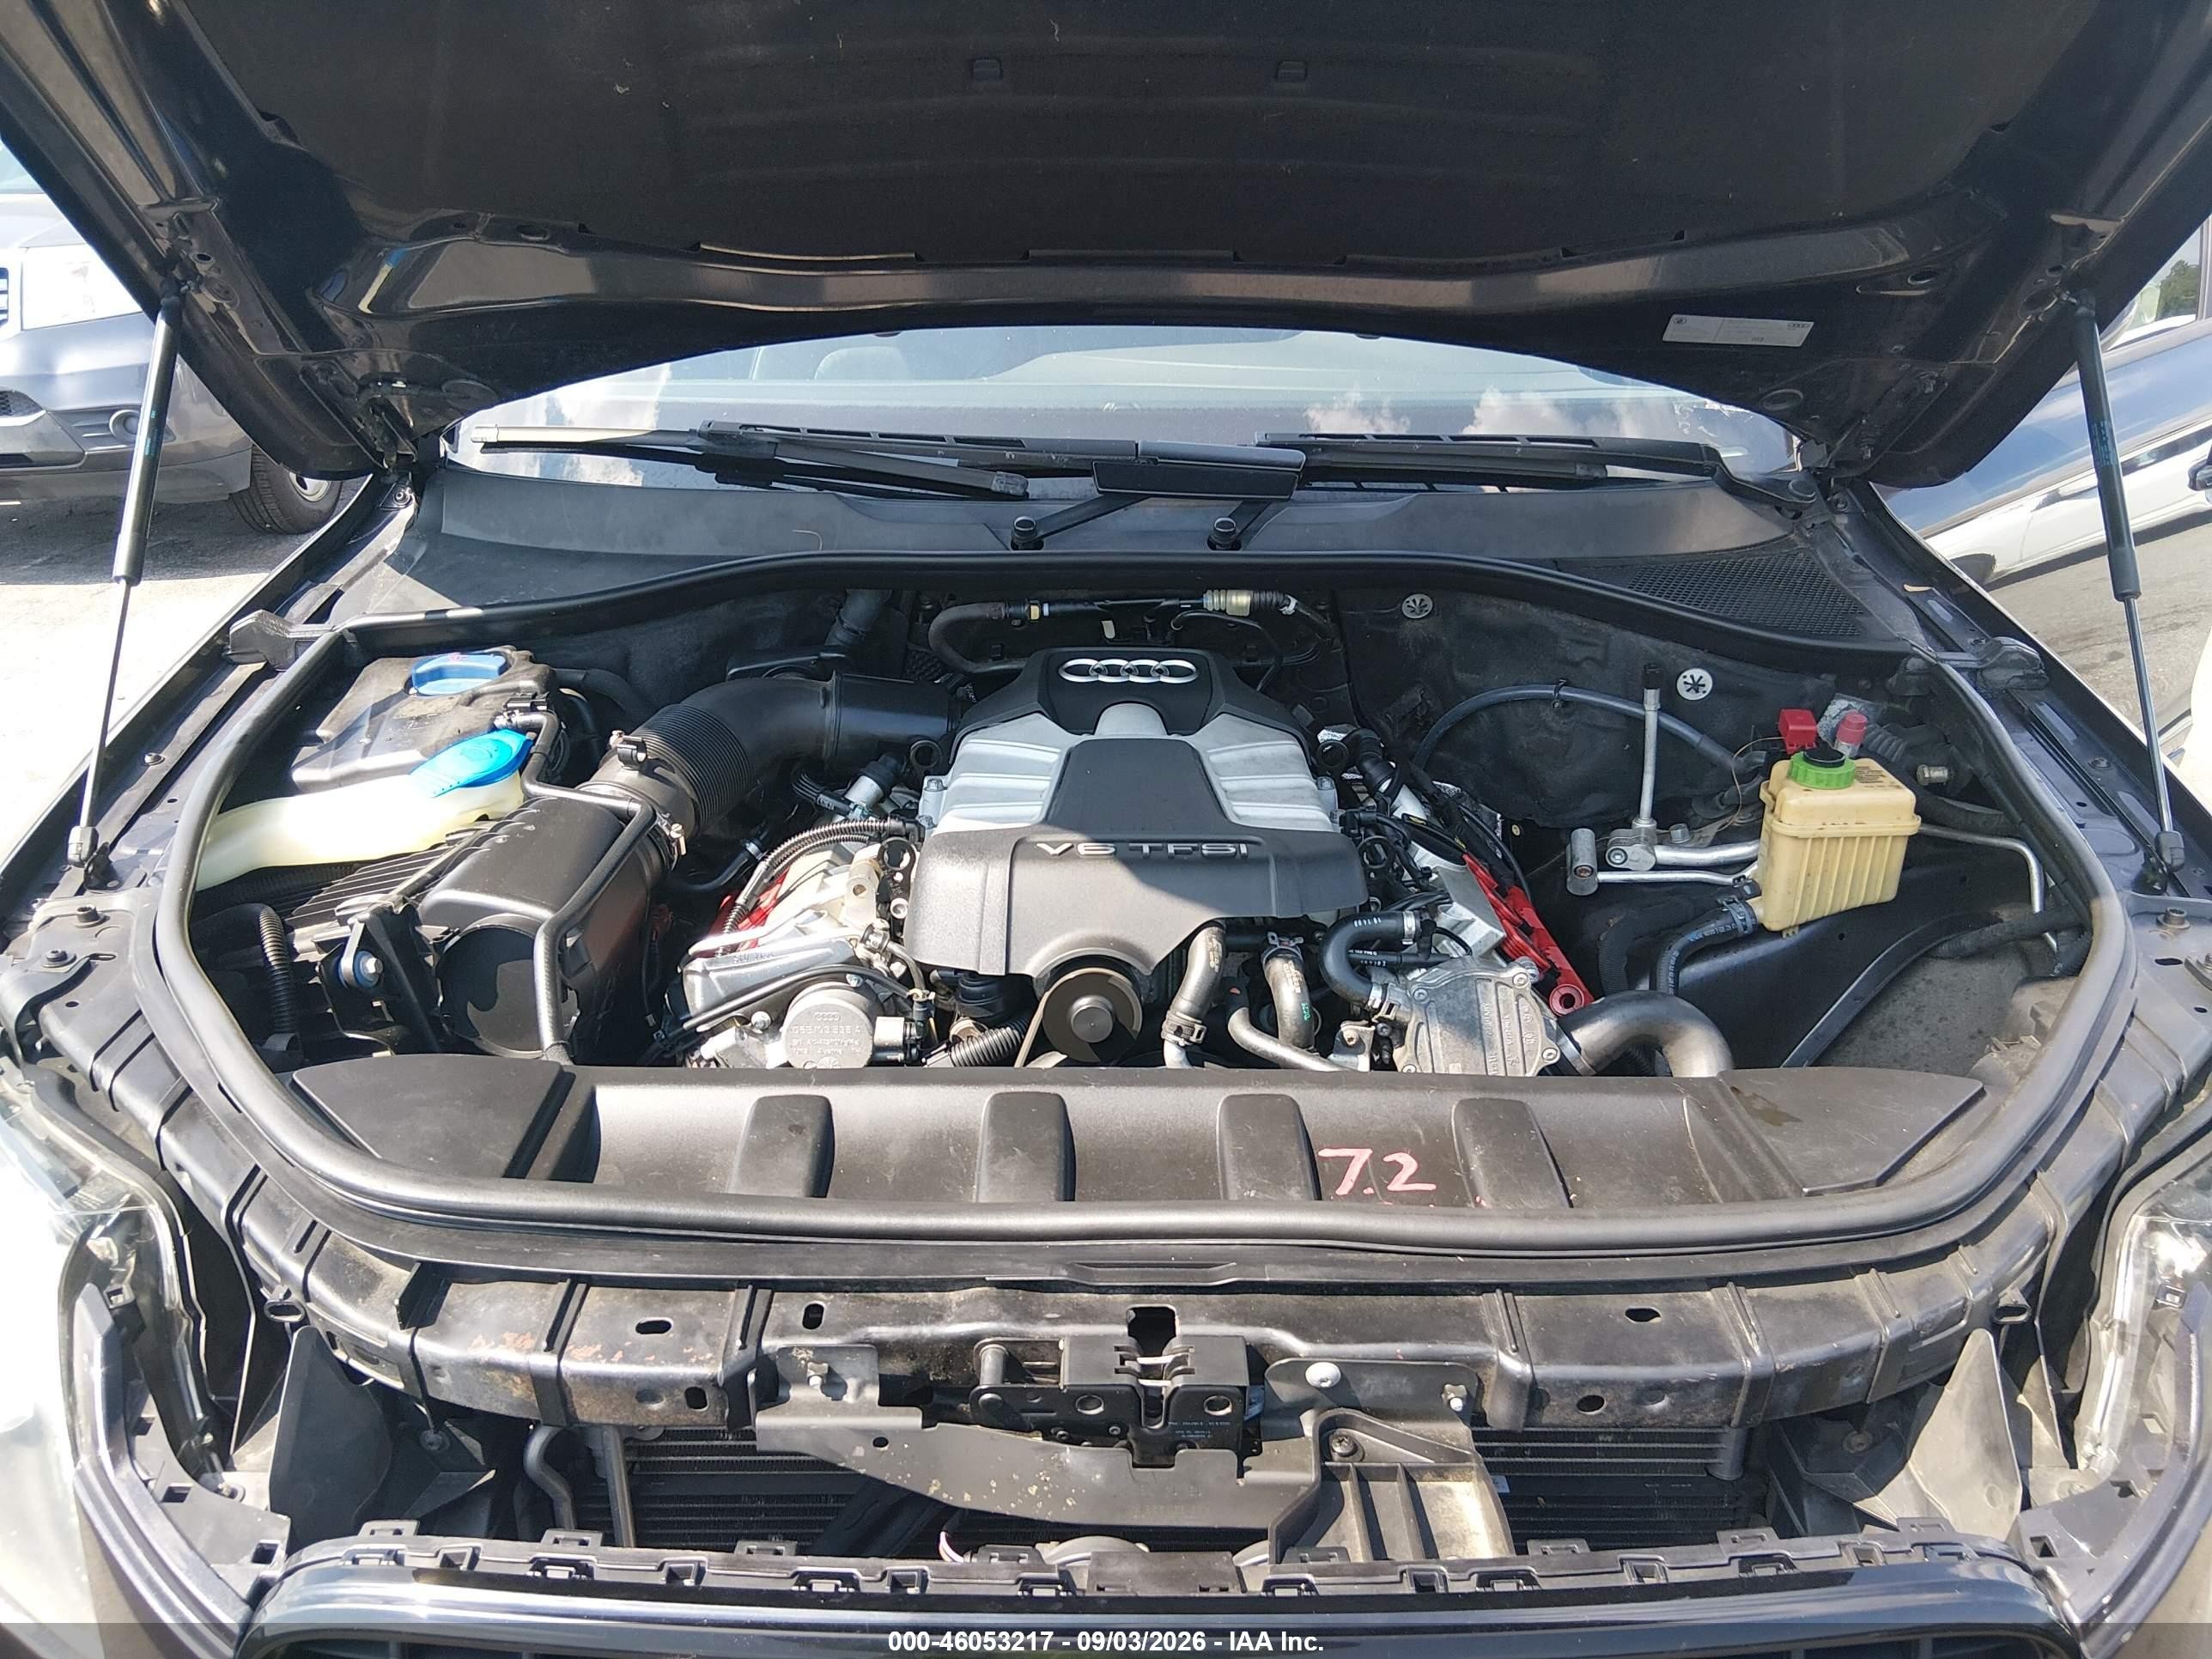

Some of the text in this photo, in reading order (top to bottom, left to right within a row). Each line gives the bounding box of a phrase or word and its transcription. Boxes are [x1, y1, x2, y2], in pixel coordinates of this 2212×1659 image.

[1036, 842, 1249, 859] V6 TFSI
[1318, 1148, 1437, 1195] 7.2
